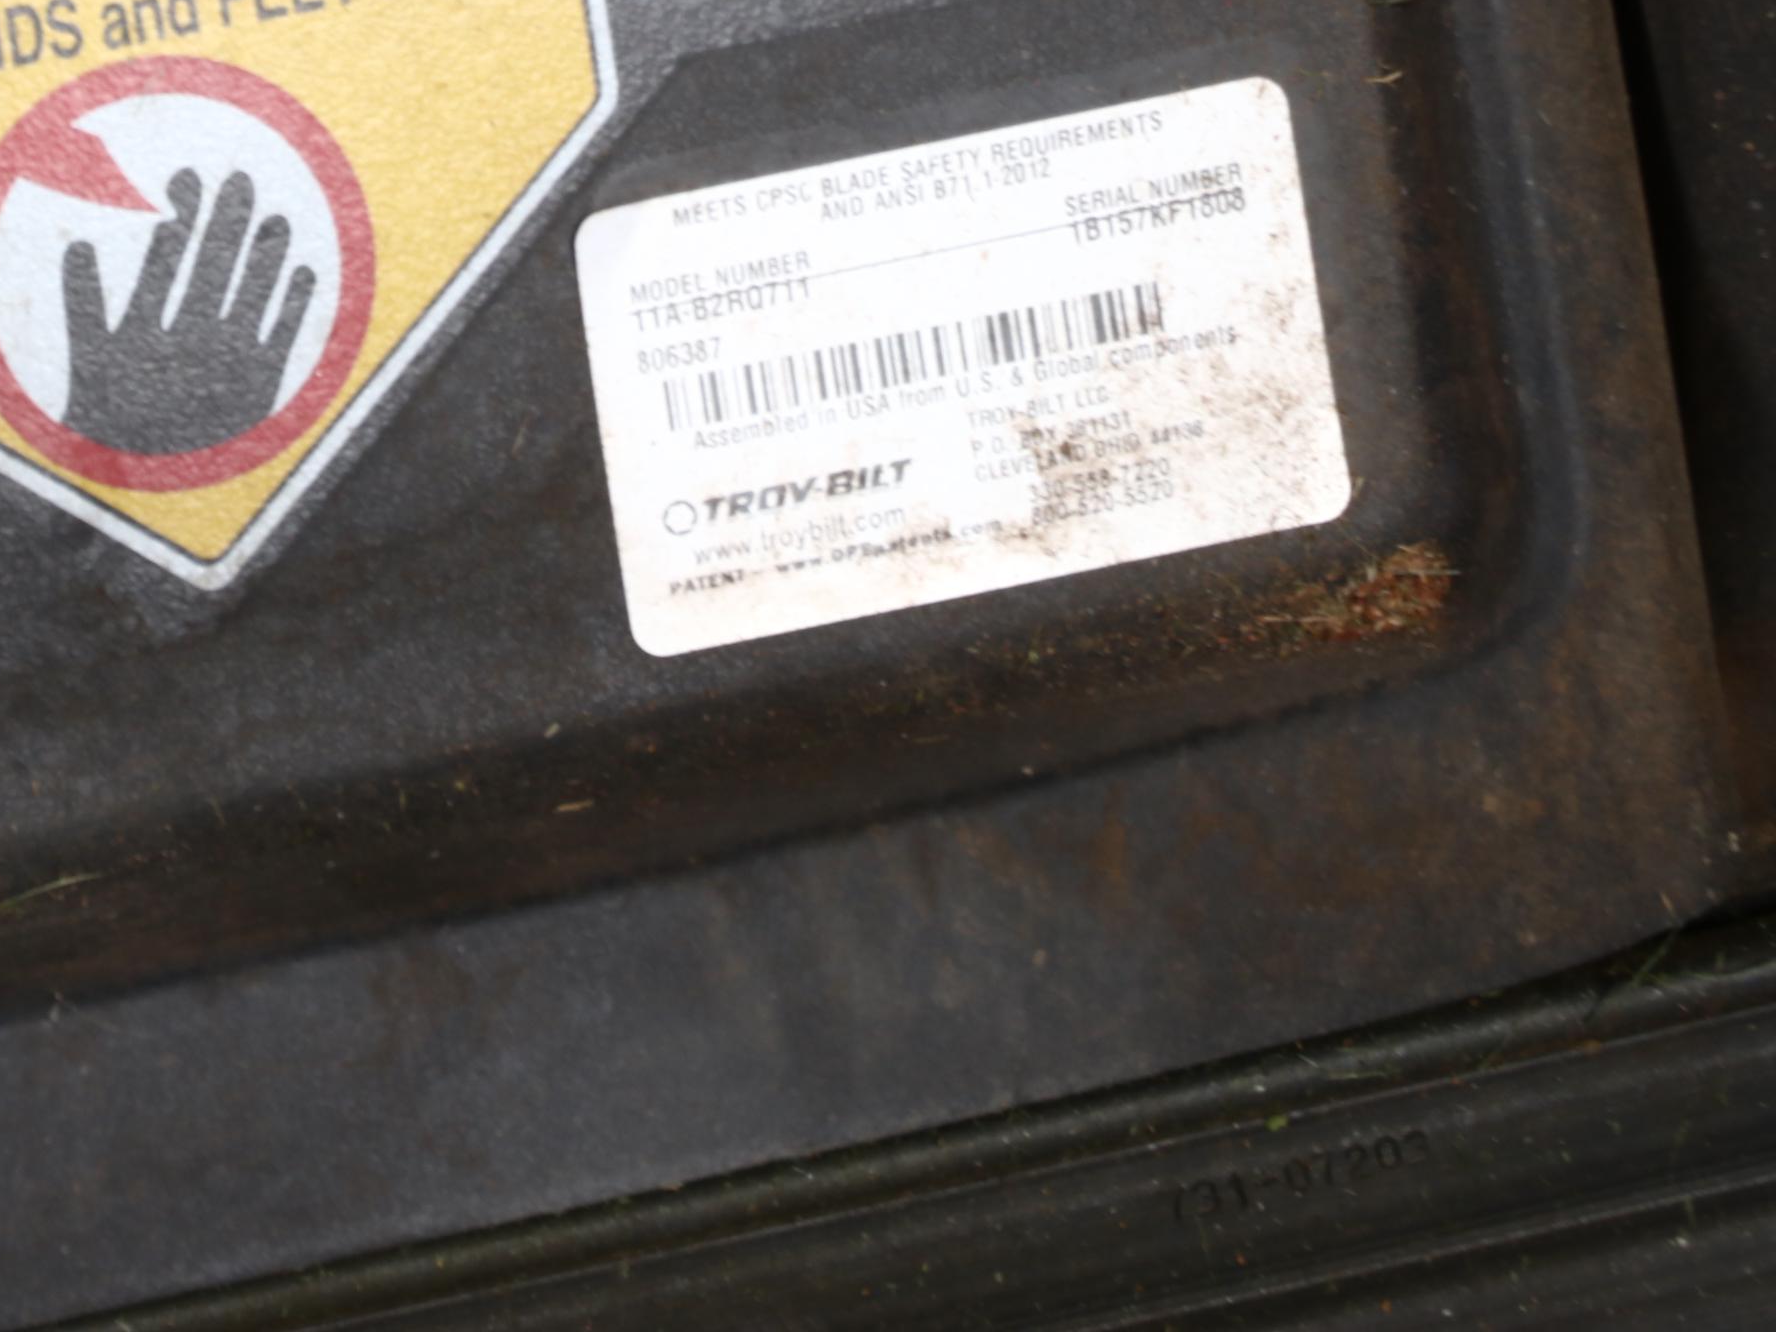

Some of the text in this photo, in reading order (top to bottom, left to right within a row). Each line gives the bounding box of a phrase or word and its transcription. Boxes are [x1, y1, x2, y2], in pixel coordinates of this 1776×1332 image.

[672, 110, 1163, 227] MEETS BLADE SAFETY REQUIREMENTS
[1064, 162, 1242, 217] SERIAL NUMBER
[819, 184, 924, 222] AND ANSI
[629, 249, 811, 305] MODEL NUMBER
[693, 352, 1100, 451] Assembled USA from Global
[701, 458, 914, 522] TROY-BILT
